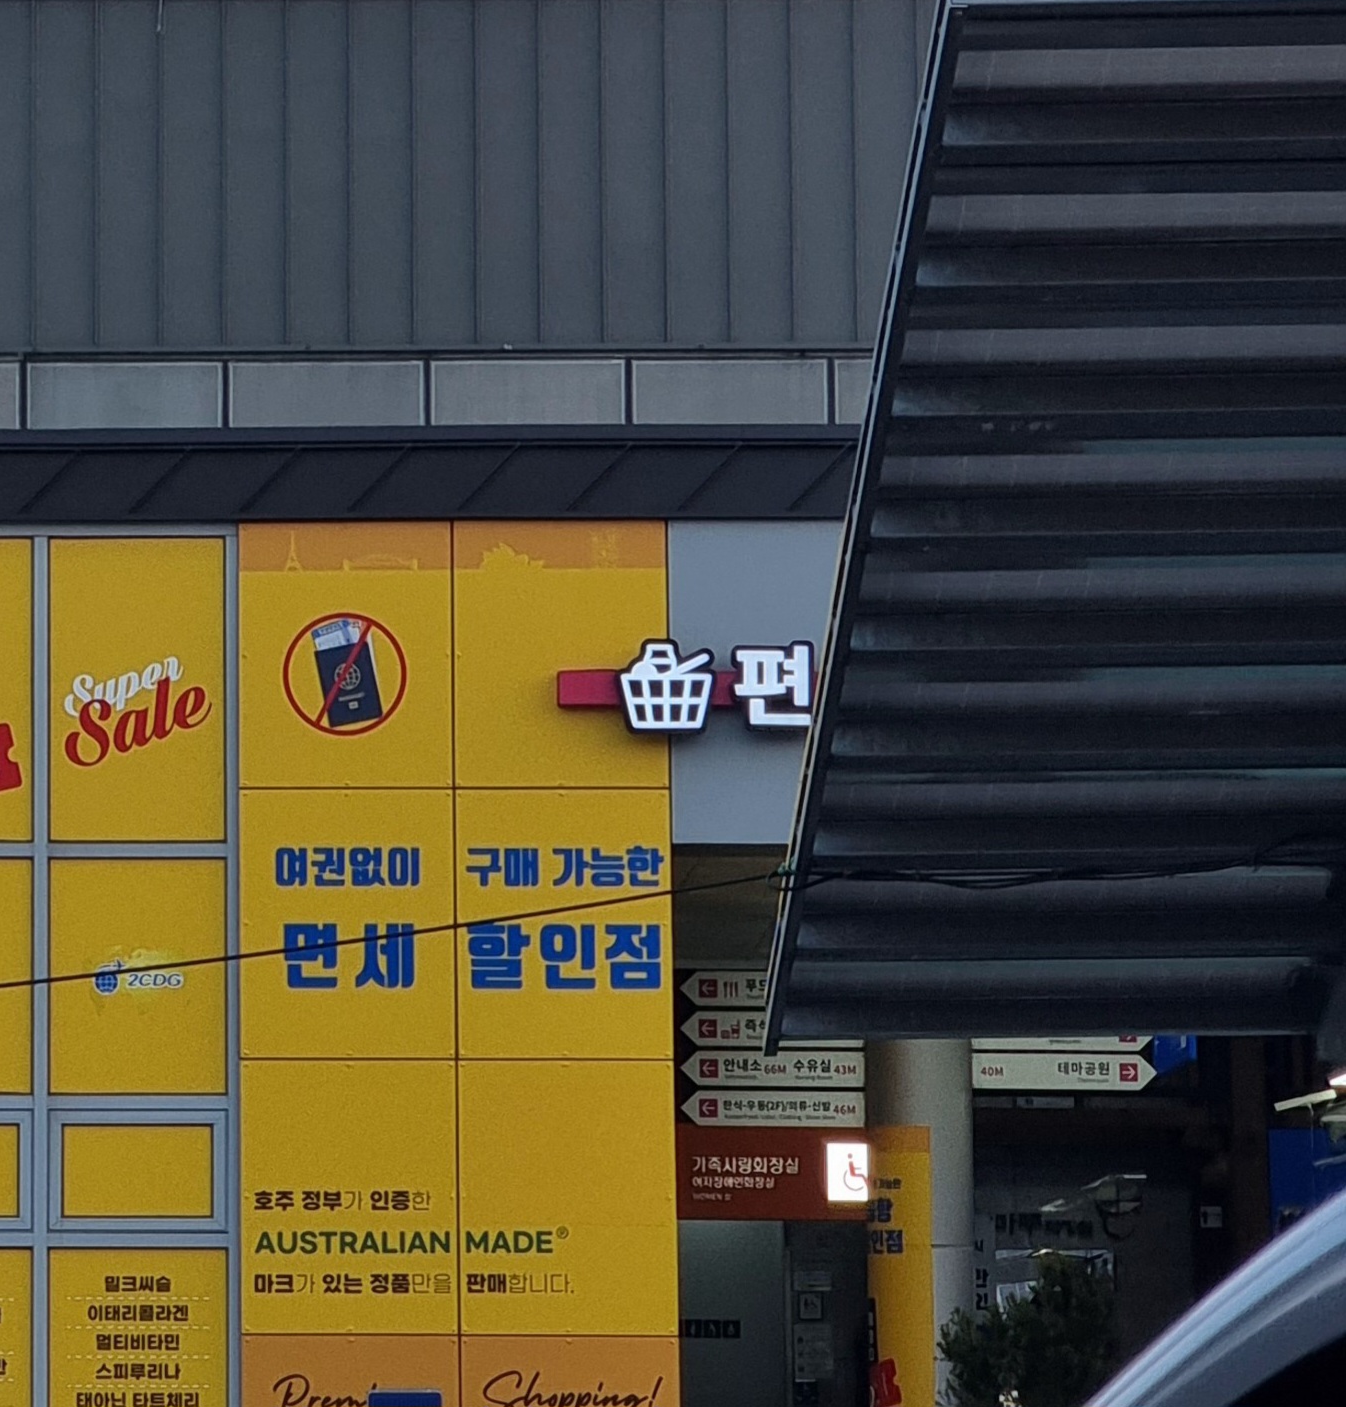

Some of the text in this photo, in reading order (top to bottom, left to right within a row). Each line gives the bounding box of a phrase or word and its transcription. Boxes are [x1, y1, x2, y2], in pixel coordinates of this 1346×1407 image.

[64, 655, 184, 718] Super
[733, 644, 812, 726] 편
[64, 676, 213, 768] Sale
[274, 845, 665, 888] 여권없이 구매 가능한
[282, 920, 663, 991] 면세 할인점
[127, 972, 182, 988] 2CDG
[723, 1058, 857, 1075] 안내소 66M 수유실 43M
[980, 1066, 1004, 1077] 40M
[1057, 1061, 1111, 1076] 테마공원
[833, 1104, 857, 1116] 46M
[253, 1190, 431, 1212] 호주 정부가 인증한
[254, 1230, 452, 1255] AUSTRALIAN
[103, 1275, 172, 1293] 밀크씨슬
[253, 1273, 576, 1295] 마크가 있는 정품만을 판매합니다.
[86, 1304, 190, 1323] 이태리콜라겐
[95, 1333, 181, 1352] 멀티비타민
[94, 1362, 182, 1381] 스피루리나
